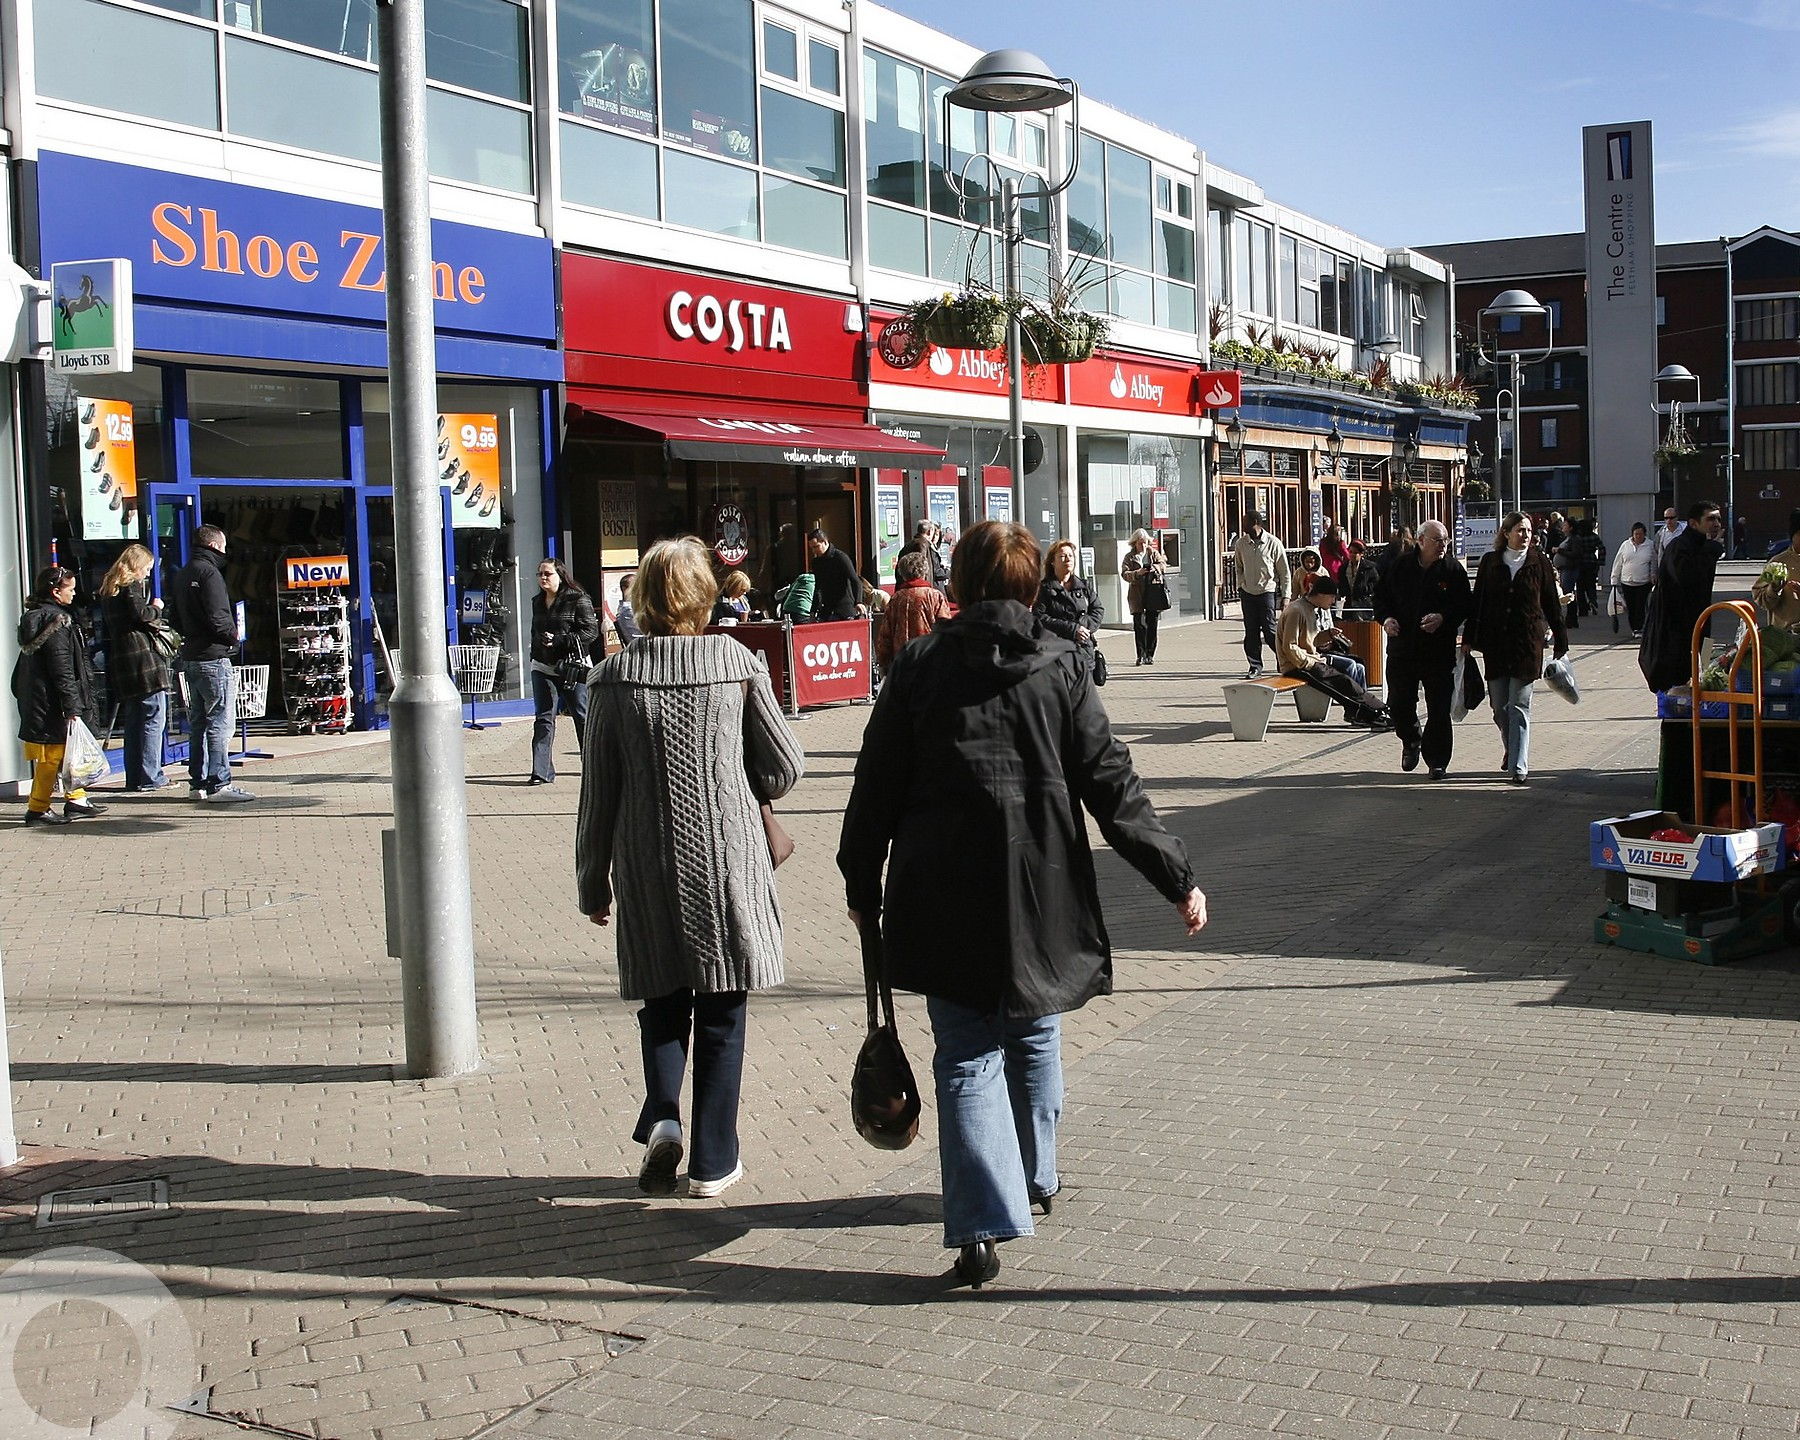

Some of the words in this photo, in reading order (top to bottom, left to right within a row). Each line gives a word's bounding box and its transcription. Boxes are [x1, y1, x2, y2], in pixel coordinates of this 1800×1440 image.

[1607, 194, 1624, 258] Centre
[1627, 192, 1636, 245] SHOPPING
[152, 202, 319, 283] Shoe
[339, 230, 486, 304] Zne
[1607, 265, 1624, 301] The
[1628, 251, 1636, 296] FELTHAM
[666, 290, 792, 353] COSTA
[61, 354, 89, 370] Lloyds
[90, 354, 110, 366] TSB
[957, 349, 1007, 388] Abbey
[1130, 374, 1165, 408] Abbey
[461, 424, 497, 448] 9.99
[812, 448, 834, 464] about
[835, 450, 857, 467] coffee
[718, 505, 741, 523] COSTA
[603, 520, 636, 537] COSTA
[715, 538, 747, 559] COFFEE
[293, 563, 342, 582] New
[464, 597, 483, 611] 9.99
[803, 640, 863, 668] COSTA
[1627, 848, 1686, 866] VALSUR
